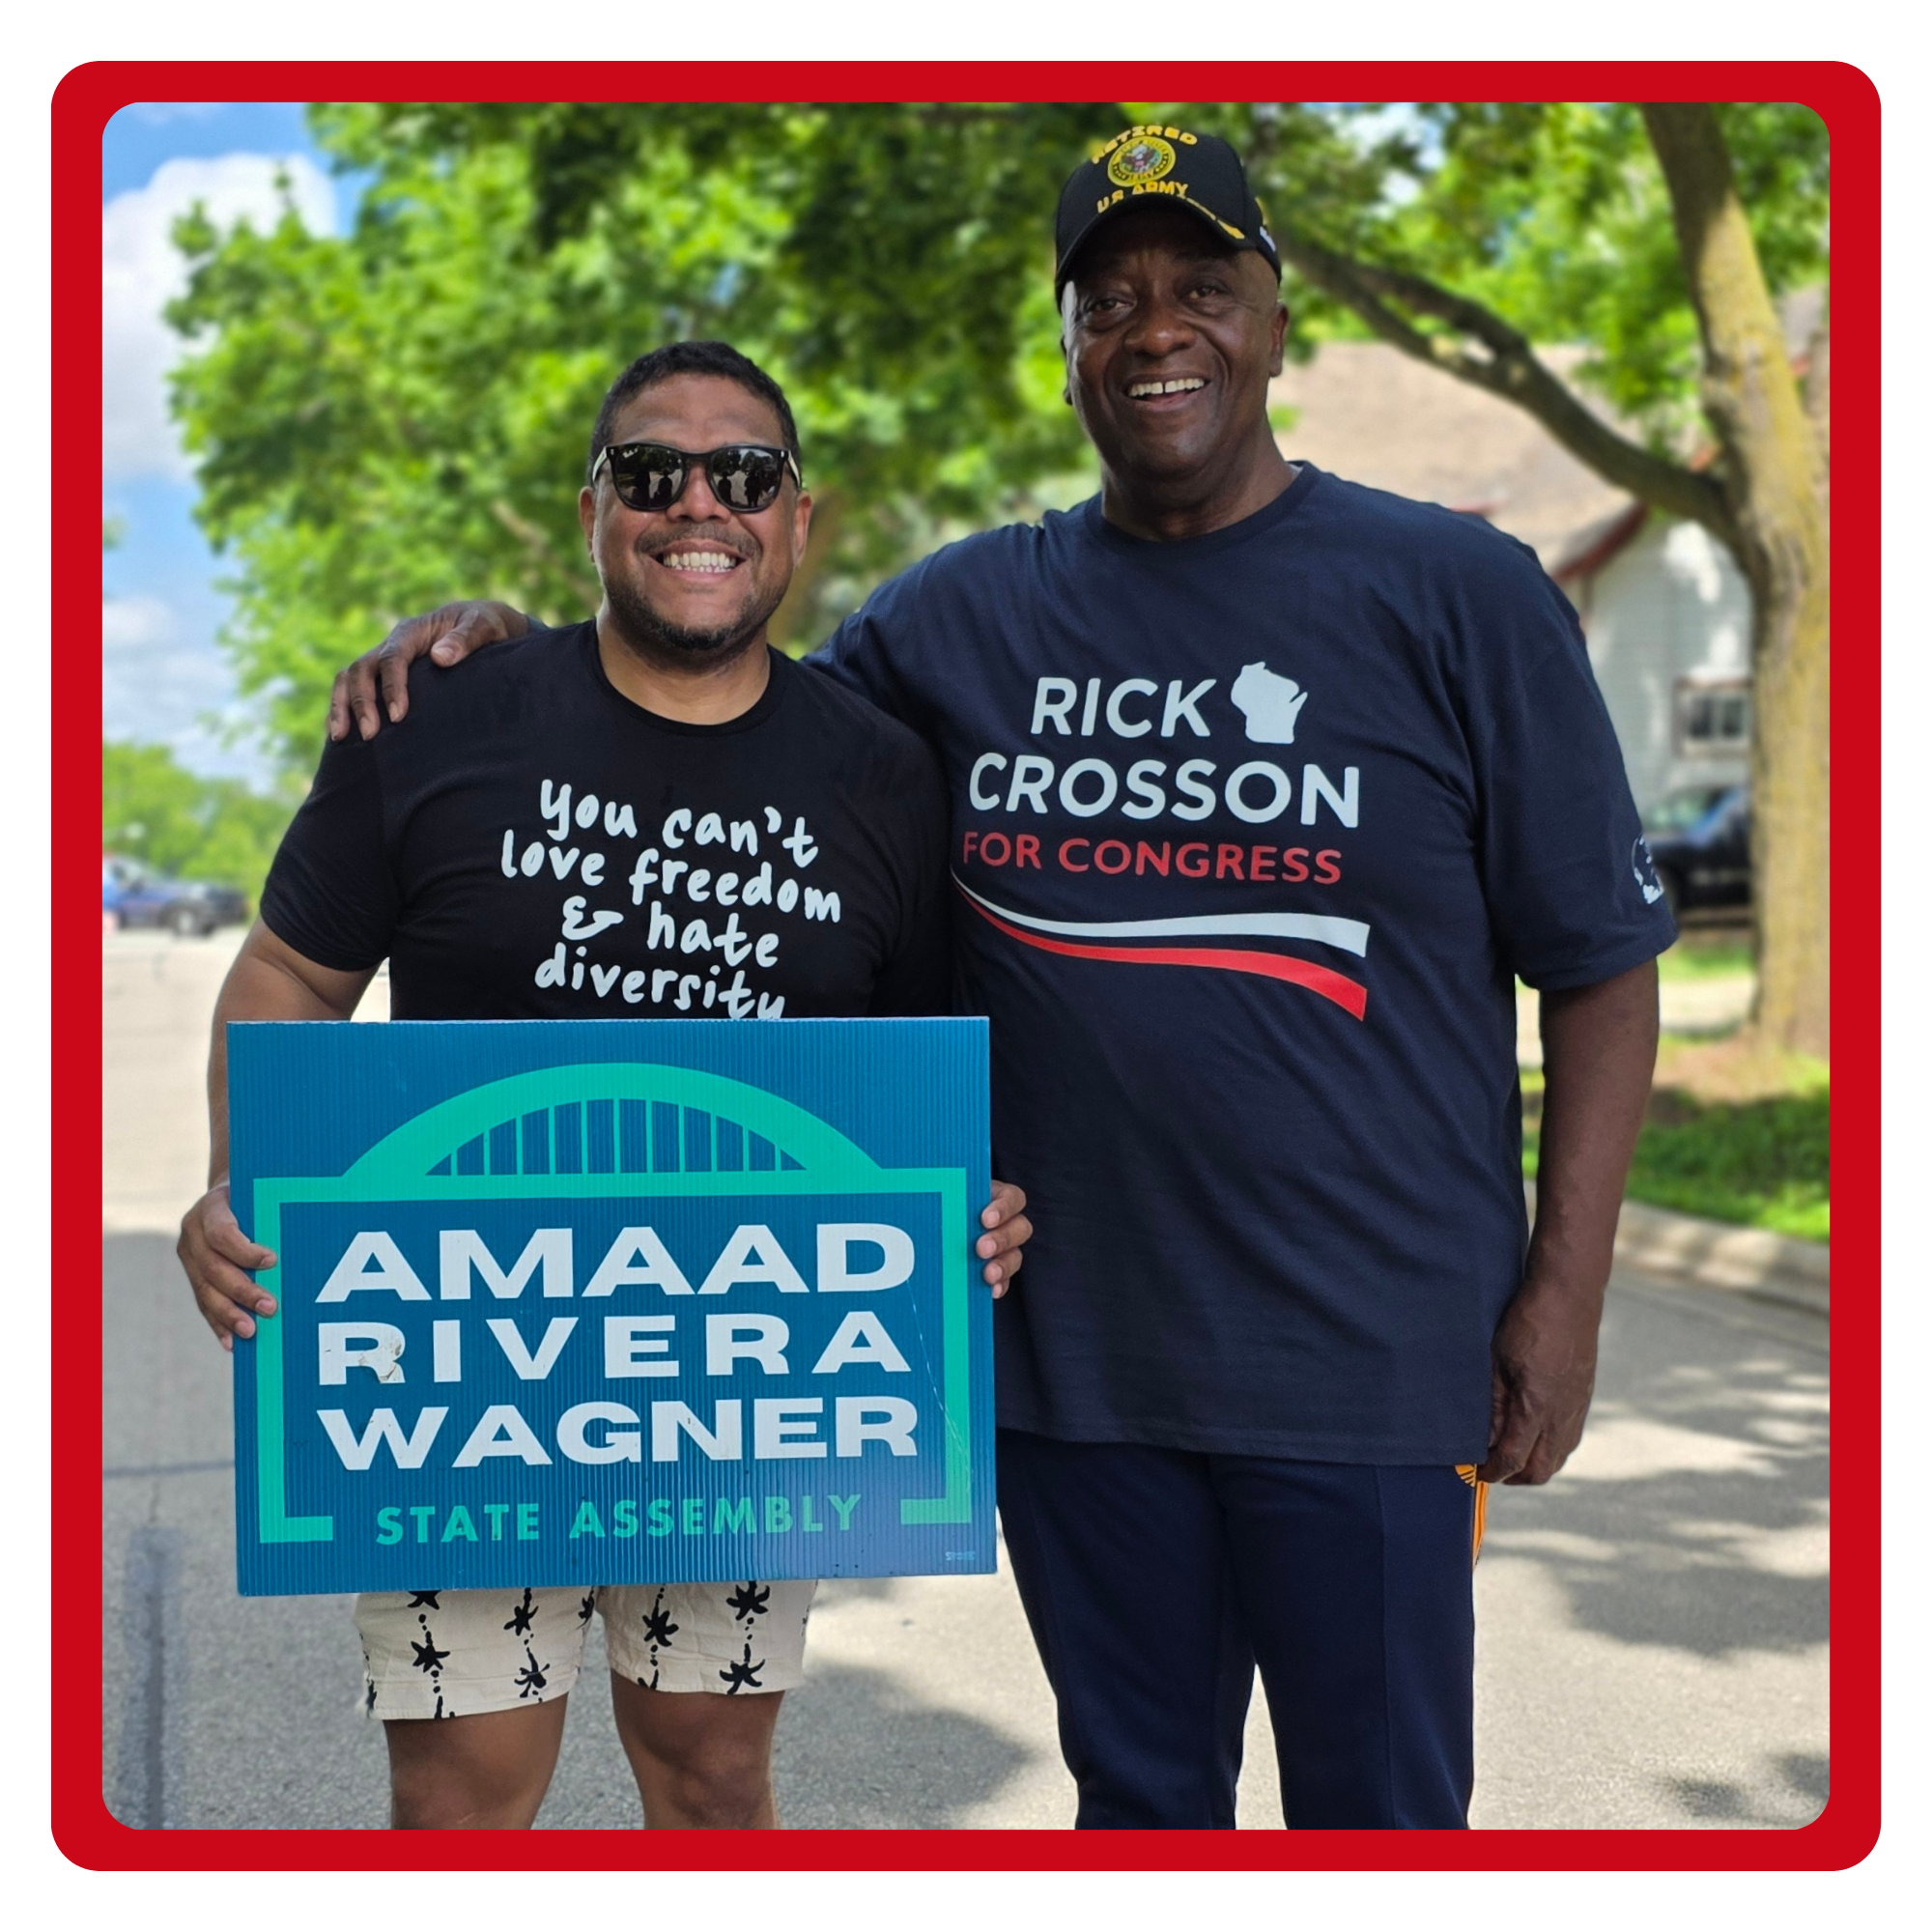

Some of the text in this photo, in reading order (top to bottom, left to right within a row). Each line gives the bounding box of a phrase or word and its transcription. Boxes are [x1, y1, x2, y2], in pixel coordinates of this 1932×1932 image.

[1131, 181, 1189, 199] ARMY
[1031, 676, 1217, 738] RICK
[540, 779, 819, 868] you can't
[969, 752, 1359, 829] CROSSON
[500, 829, 840, 923] love freedom
[963, 832, 1342, 884] FOR CONGRESS
[561, 895, 780, 968] & hate
[534, 942, 785, 1020] diversity
[315, 1223, 916, 1303] AMAAD
[318, 1311, 912, 1386] RIVERA
[316, 1397, 919, 1471] WAGNER
[376, 1493, 862, 1546] STATE ASSEMBLY
